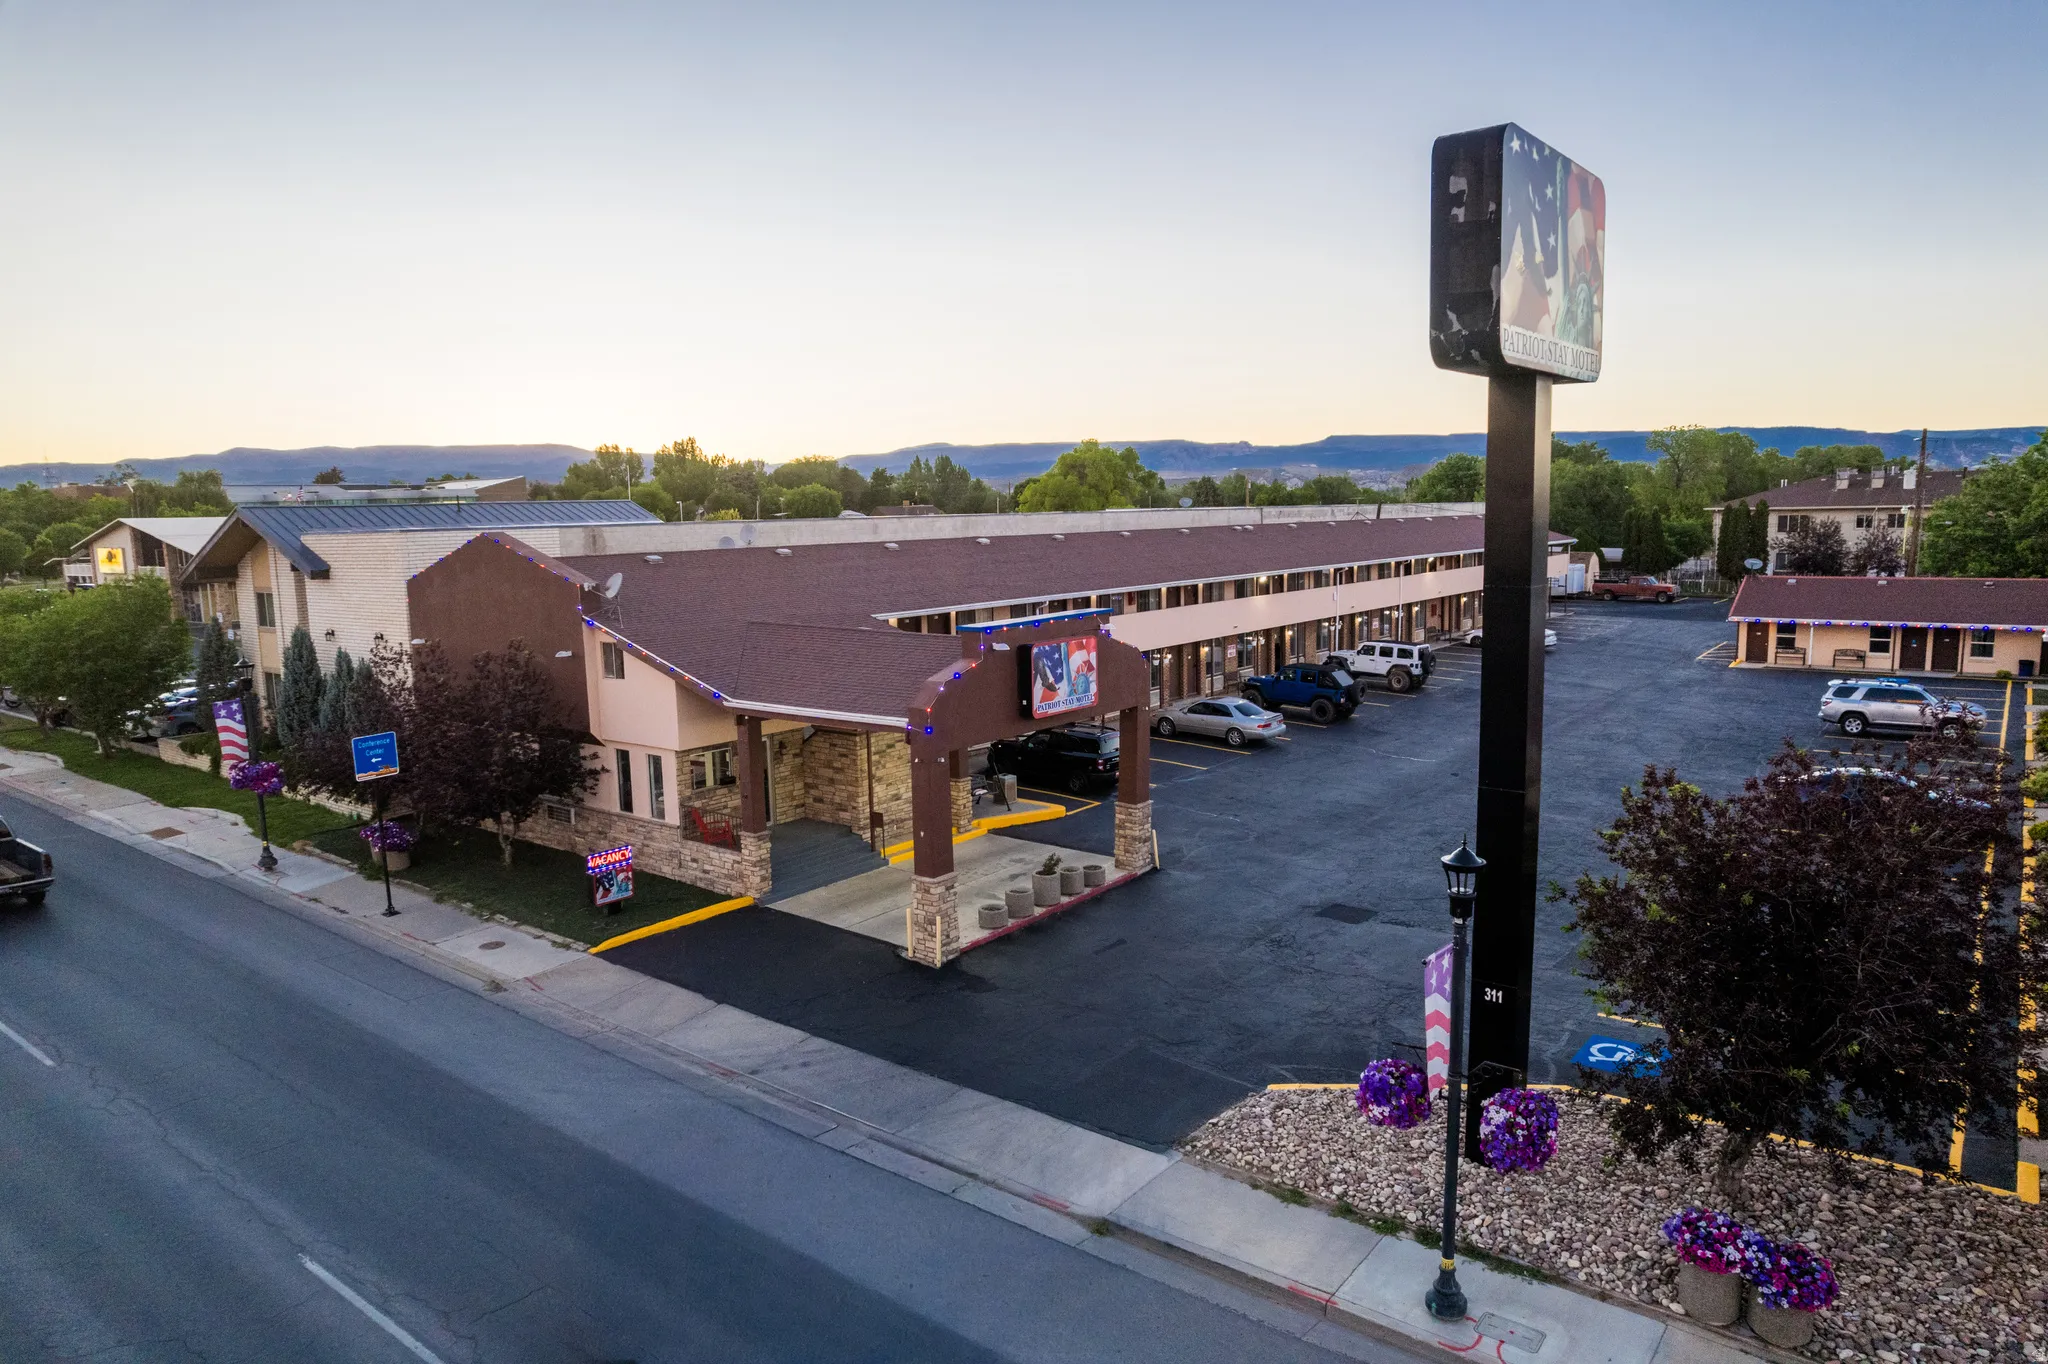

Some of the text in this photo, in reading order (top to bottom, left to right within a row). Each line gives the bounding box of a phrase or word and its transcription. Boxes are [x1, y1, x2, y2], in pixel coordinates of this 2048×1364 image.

[1503, 328, 1600, 373] PATRIOT STAY MOTEL
[1037, 694, 1094, 711] PATRIOT STAY MOTEL
[358, 739, 390, 748] Conference
[365, 748, 384, 756] Center
[590, 850, 629, 867] VACANCY
[1485, 988, 1503, 1003] 311
